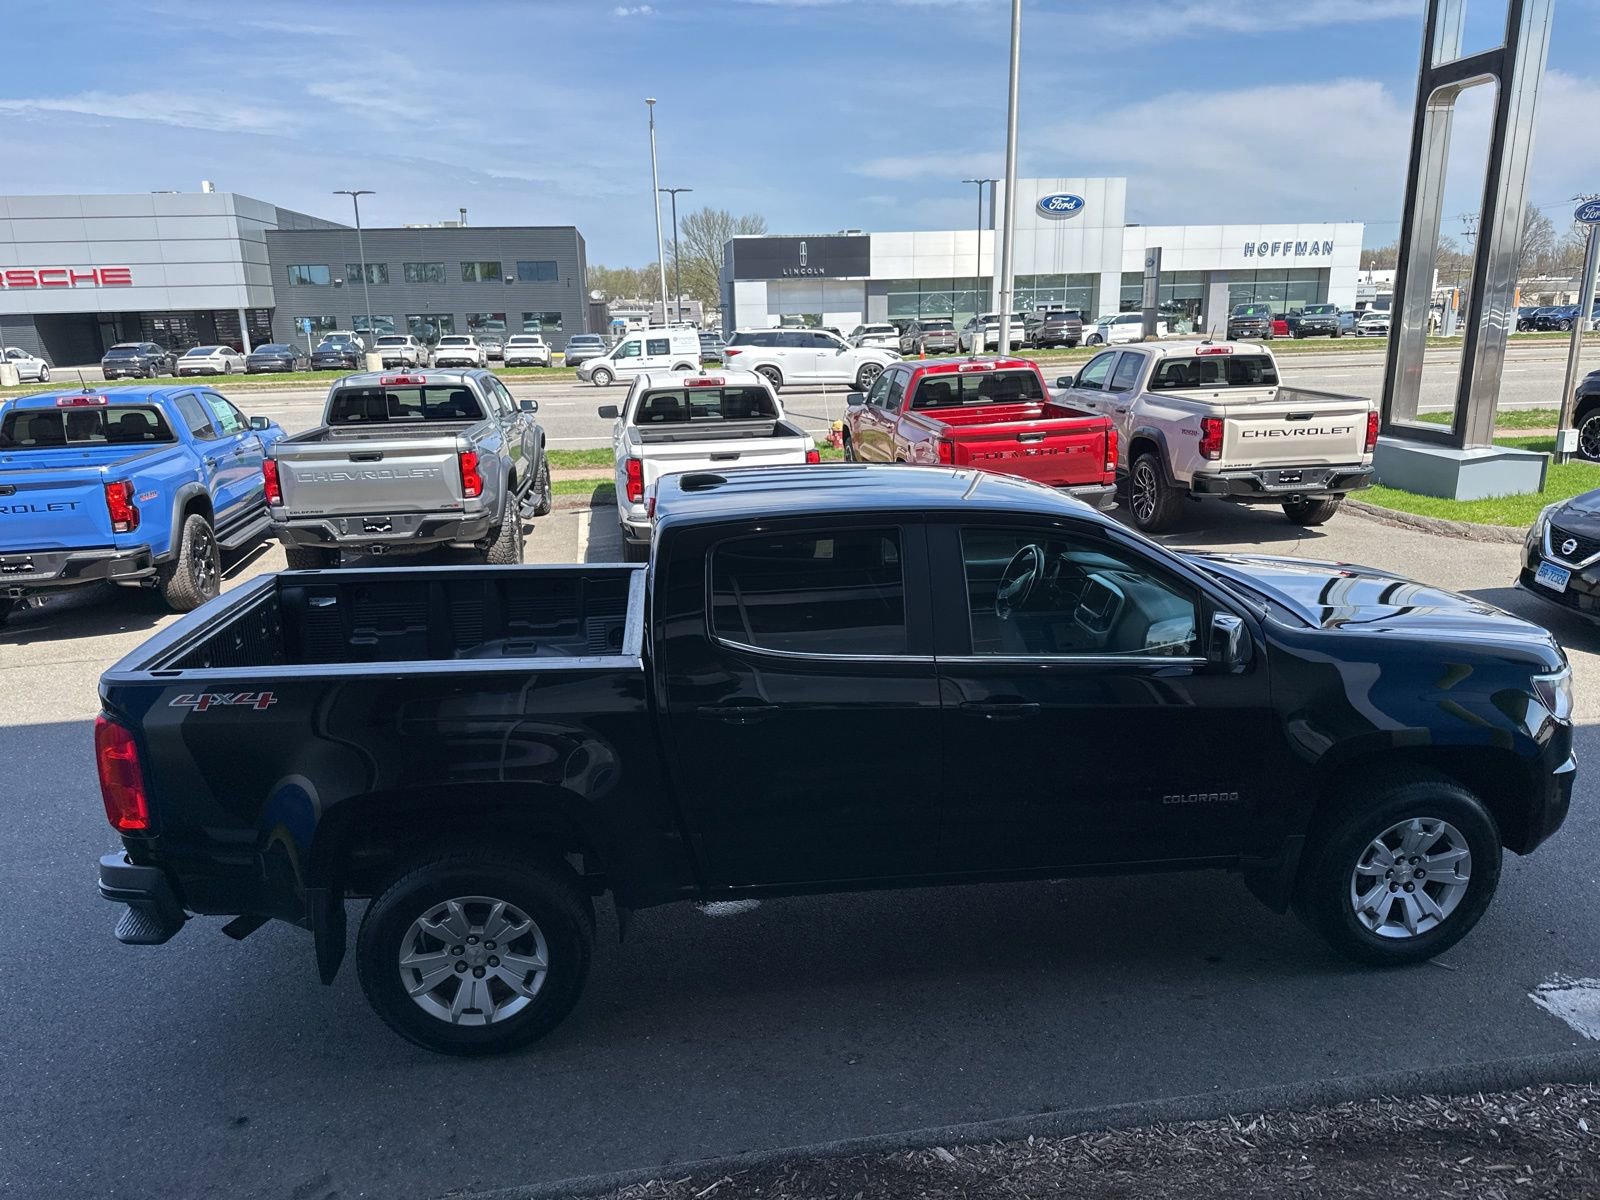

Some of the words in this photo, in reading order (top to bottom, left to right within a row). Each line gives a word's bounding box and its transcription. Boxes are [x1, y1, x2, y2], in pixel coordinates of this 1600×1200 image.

[1048, 197, 1077, 210] Ford
[1244, 240, 1334, 257] HOFFMAN
[0, 267, 132, 288] SCHE
[1242, 426, 1354, 438] CHEVROLET
[297, 468, 439, 483] CHEVROLET
[168, 691, 278, 712] 4x4
[1162, 792, 1238, 804] COLORADO
